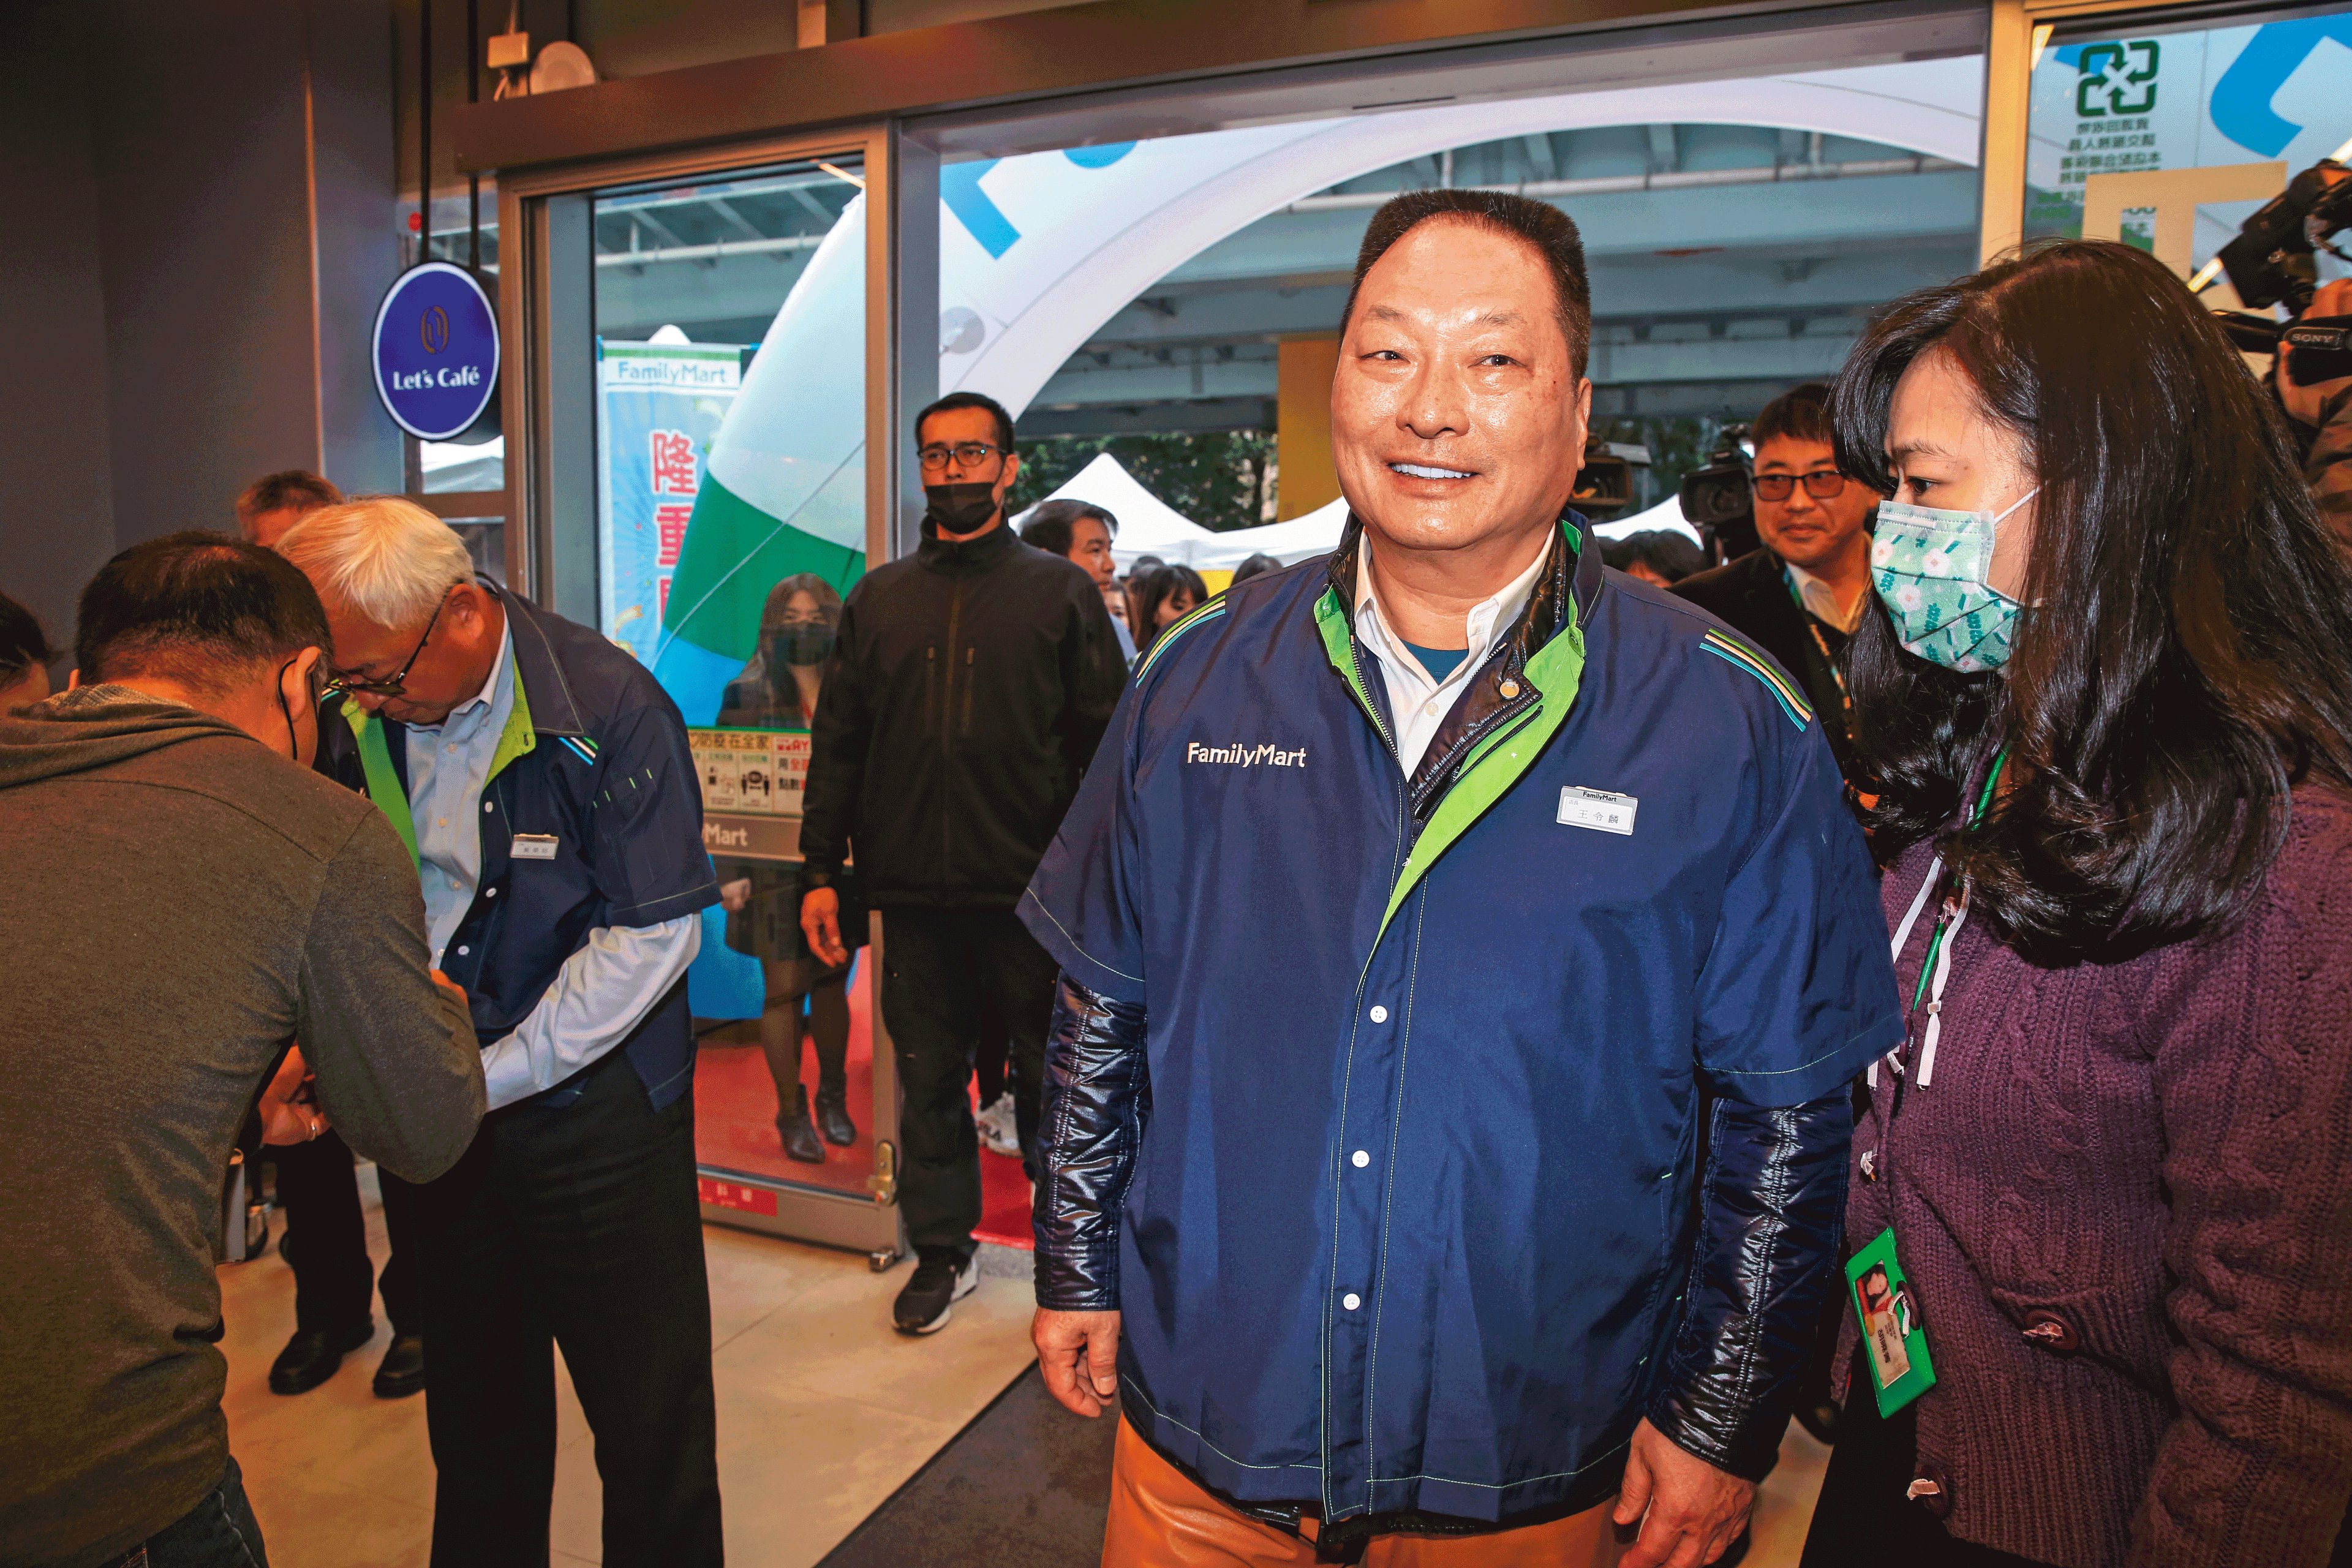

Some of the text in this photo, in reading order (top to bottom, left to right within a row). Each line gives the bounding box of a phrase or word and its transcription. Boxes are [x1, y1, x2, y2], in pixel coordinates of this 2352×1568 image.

[2292, 333, 2334, 343] SONY
[393, 365, 481, 390] Let's Café
[619, 360, 725, 384] FamilyMart
[1187, 742, 1306, 768] FamilyMart
[1582, 791, 1618, 802] FamilyMart
[1577, 809, 1619, 824] 王令麟
